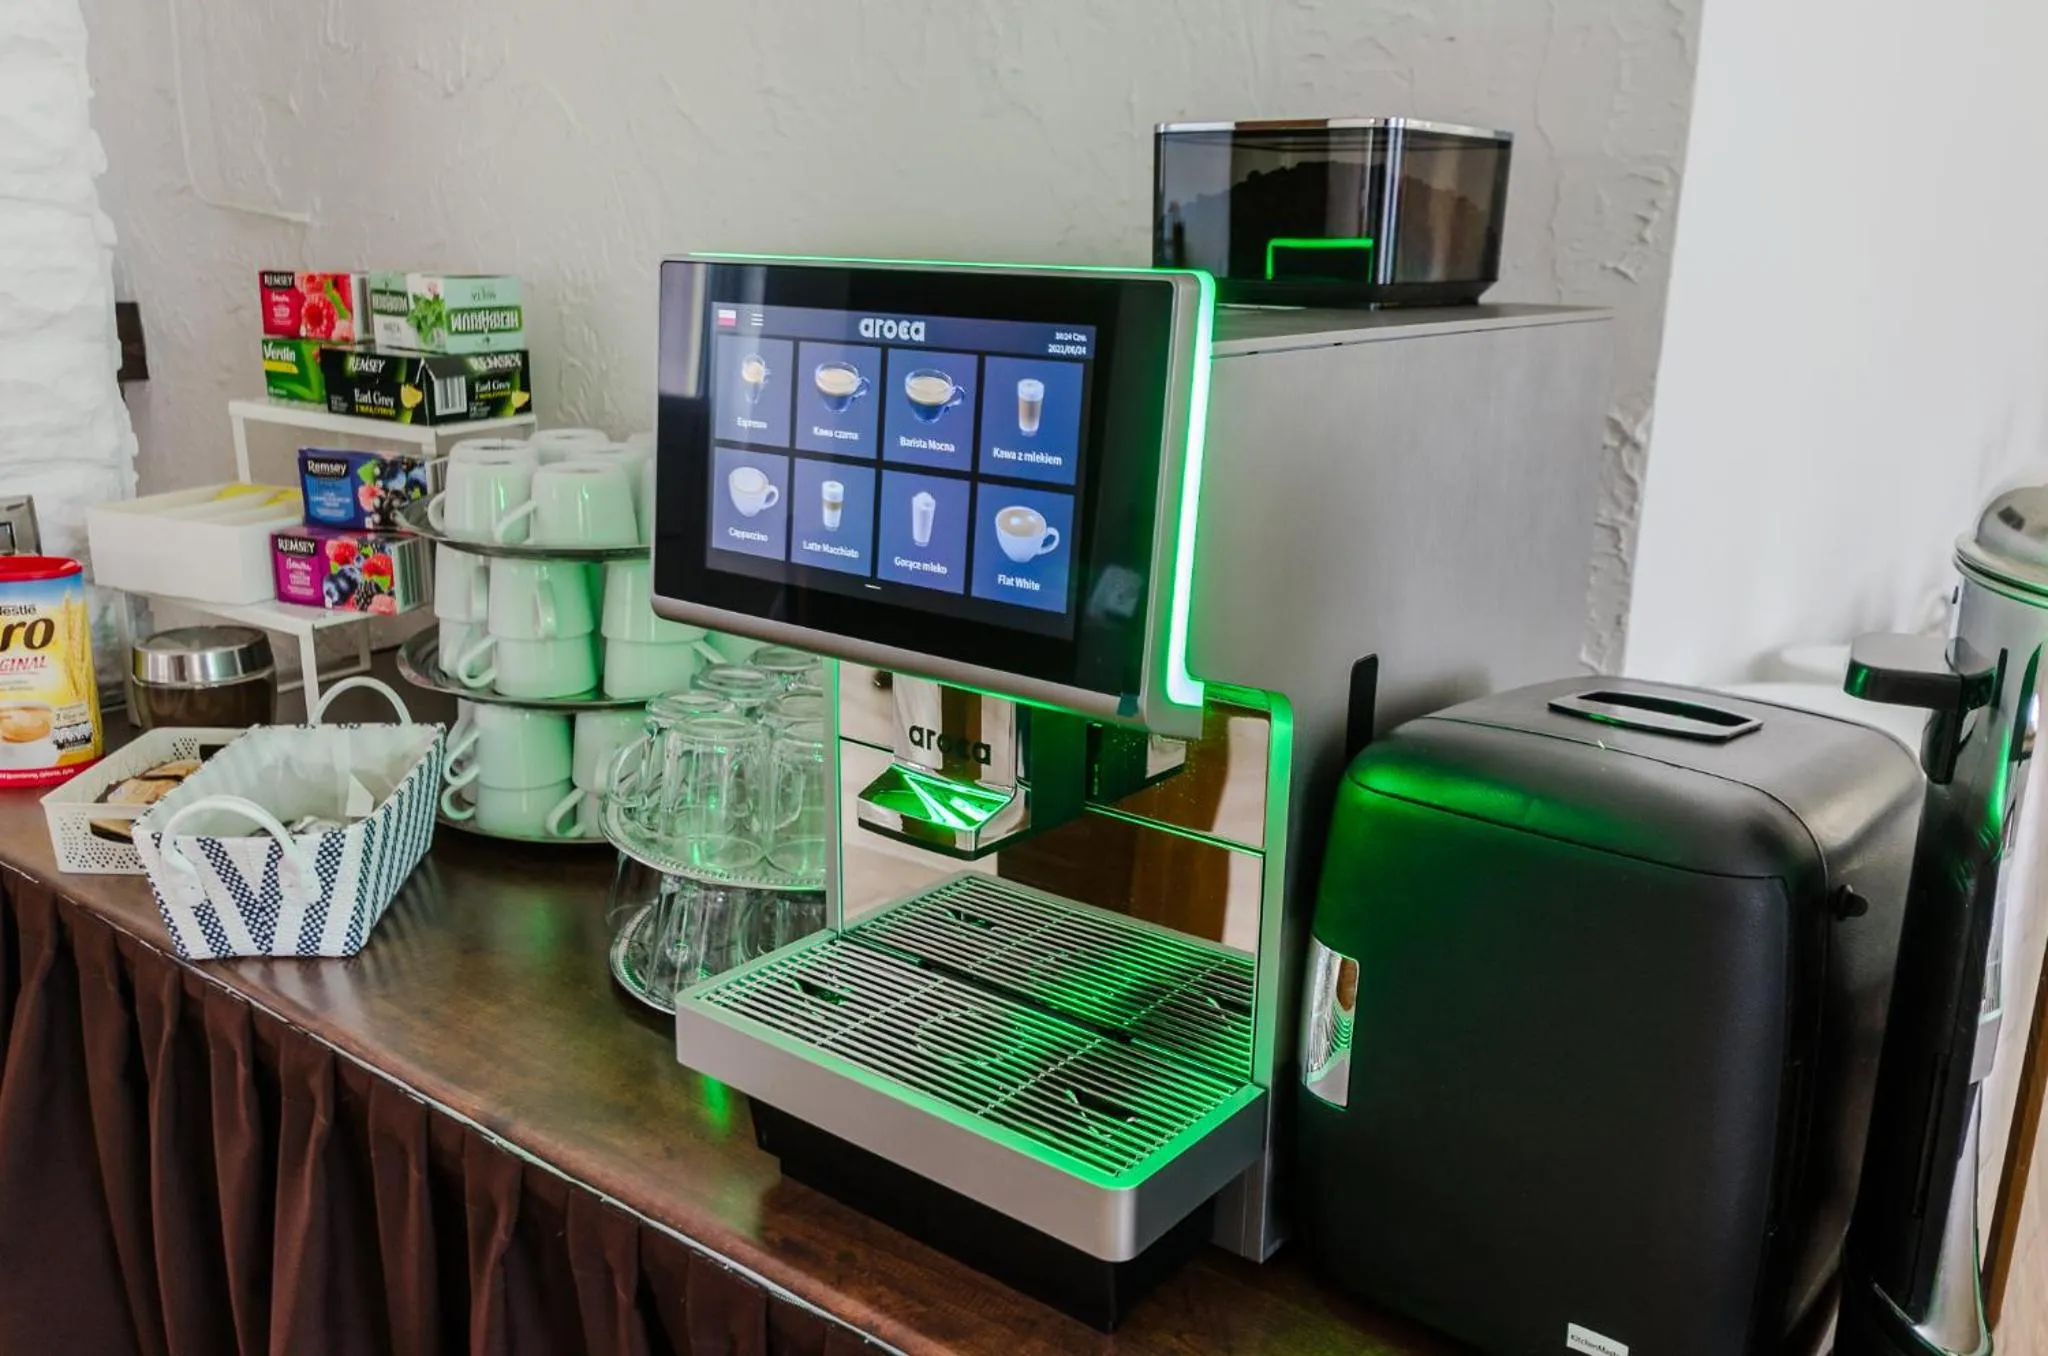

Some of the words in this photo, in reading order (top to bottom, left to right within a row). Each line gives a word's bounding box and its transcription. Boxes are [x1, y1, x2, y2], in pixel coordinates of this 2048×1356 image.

[264, 273, 293, 286] REMSEY
[859, 317, 925, 342] aroca
[348, 355, 386, 374] REMSEY
[354, 387, 372, 404] Earl
[373, 390, 395, 409] Grey
[737, 416, 767, 429] Espresso
[813, 426, 833, 437] Kawa
[834, 430, 859, 440] czarna
[899, 436, 927, 449] Barista
[928, 440, 956, 452] Mocna
[992, 447, 1016, 460] Kawa
[1017, 452, 1023, 461] z
[1024, 451, 1062, 466] mlekiem
[307, 460, 347, 476] Remsey
[278, 538, 315, 554] REMSEY
[803, 540, 821, 552] Latte
[821, 543, 860, 558] Macchiato
[894, 556, 921, 571] Gorące
[922, 561, 948, 574] mleko
[997, 574, 1015, 587] Flat
[1015, 577, 1040, 591] White
